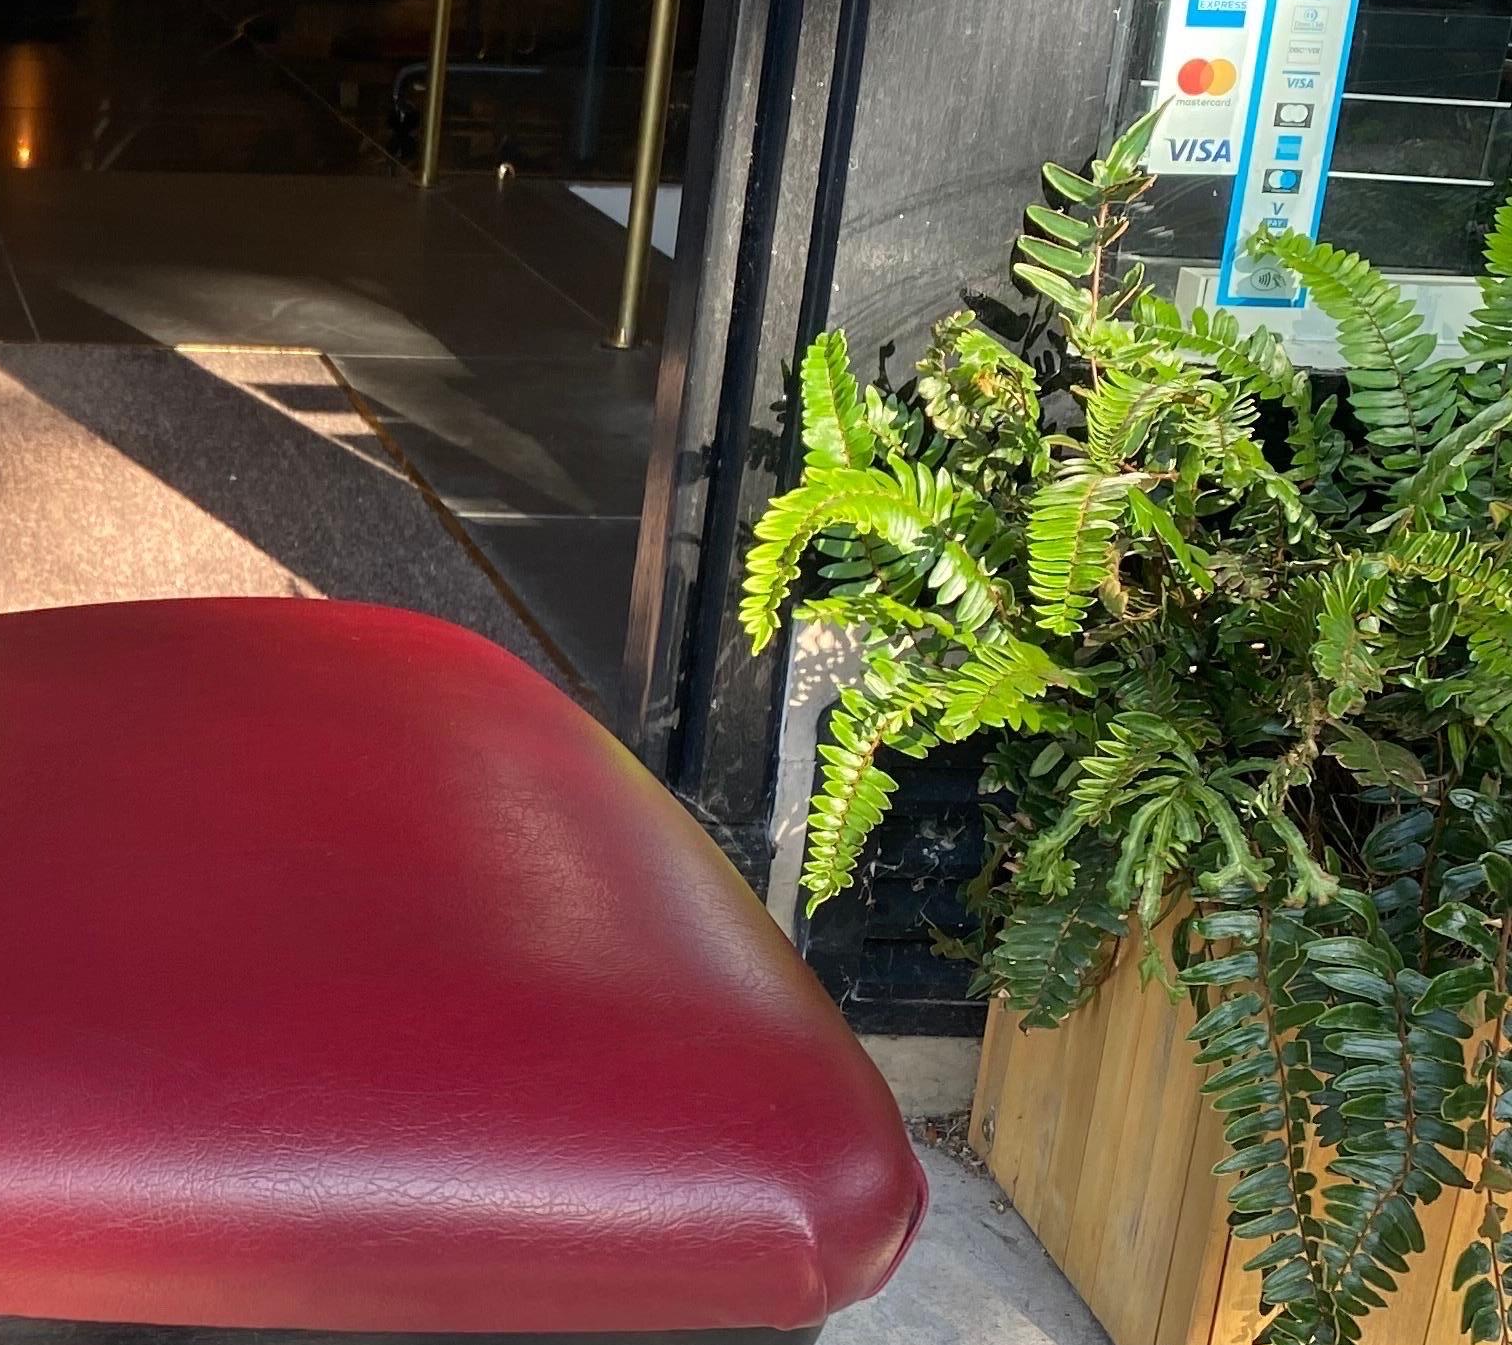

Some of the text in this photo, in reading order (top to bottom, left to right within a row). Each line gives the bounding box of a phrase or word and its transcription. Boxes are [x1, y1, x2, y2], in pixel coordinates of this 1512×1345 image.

[1199, 0, 1248, 10] EXPRESS
[1287, 77, 1315, 89] VISA
[1175, 97, 1232, 108] mastercard
[1164, 137, 1232, 163] VISA
